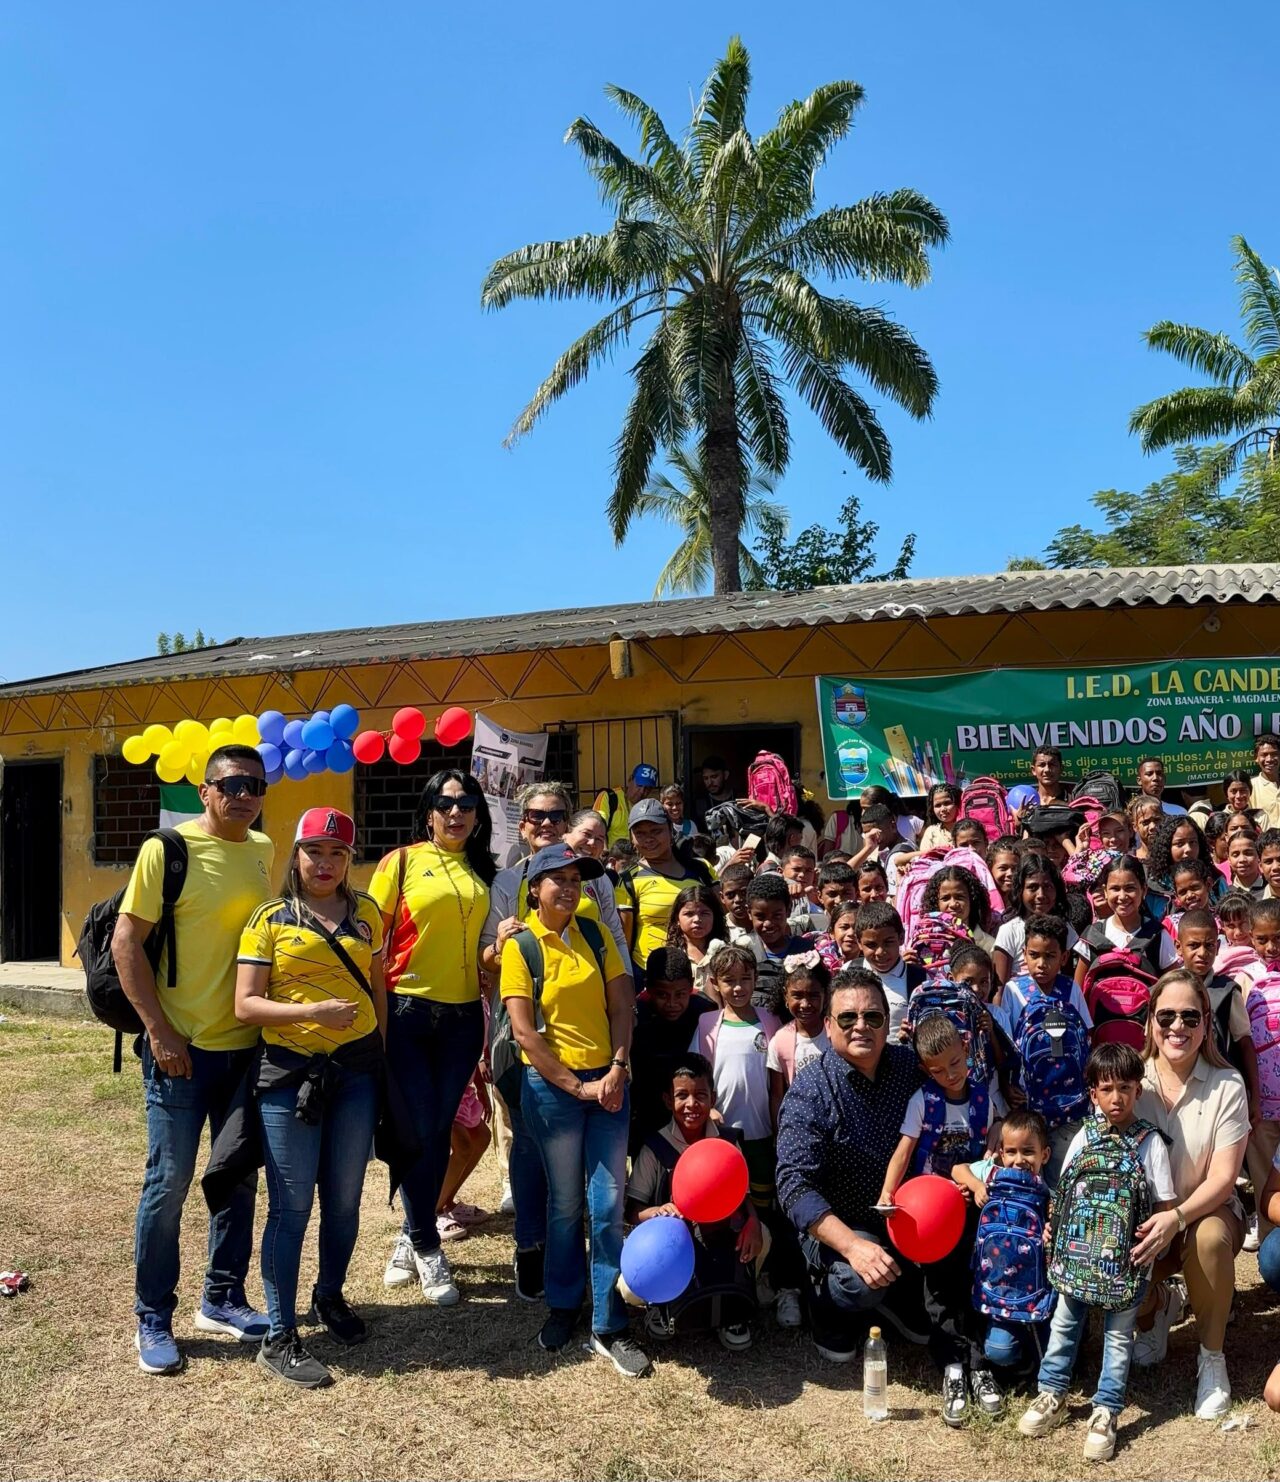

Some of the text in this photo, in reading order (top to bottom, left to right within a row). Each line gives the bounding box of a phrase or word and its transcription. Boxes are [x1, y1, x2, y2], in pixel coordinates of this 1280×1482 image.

[1066, 674, 1140, 699] I.E.D.
[1151, 670, 1185, 695] LA
[1146, 697, 1173, 707] ZONA
[1174, 694, 1224, 706] BANANERA
[957, 716, 1167, 750] BIENVENIDOS
[1178, 707, 1242, 742] AÑO
[1076, 755, 1099, 769] dijo
[1101, 757, 1109, 766] a
[1111, 756, 1134, 765] sus
[1205, 750, 1215, 761] A
[1216, 749, 1228, 760] la
[1176, 762, 1212, 773] Señor
[1214, 760, 1228, 771] de
[1231, 758, 1242, 769] la
[641, 767, 657, 781] 3K
[1187, 772, 1218, 782] (MATEO
